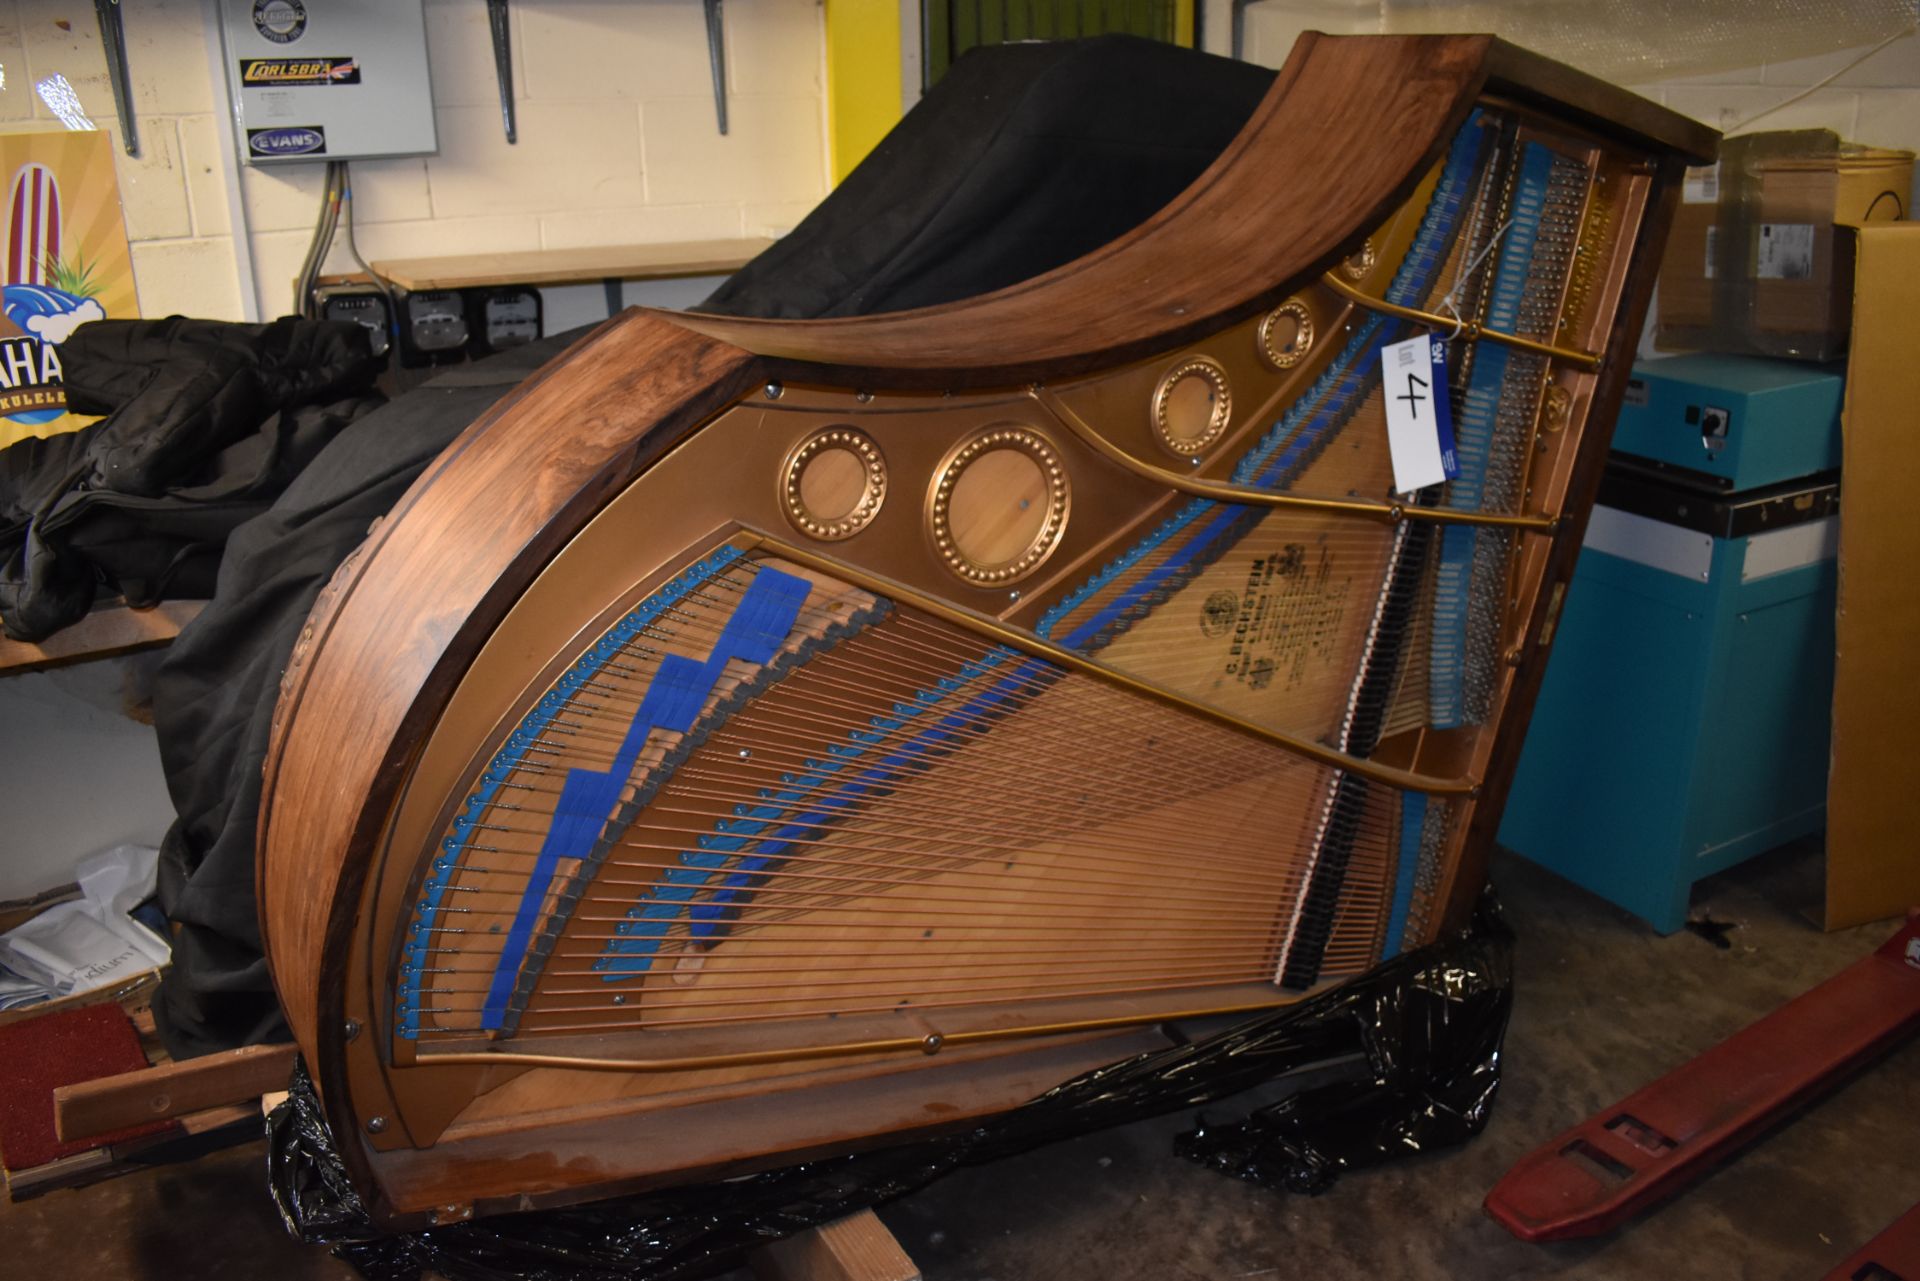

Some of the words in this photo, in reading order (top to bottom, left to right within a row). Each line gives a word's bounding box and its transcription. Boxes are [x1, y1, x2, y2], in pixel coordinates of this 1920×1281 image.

[256, 134, 314, 148] EVANS
[1398, 344, 1415, 368] Lot
[0, 391, 66, 409] KULELE
[1397, 372, 1428, 420] 4
[1230, 560, 1265, 655] BECHSTEIN
